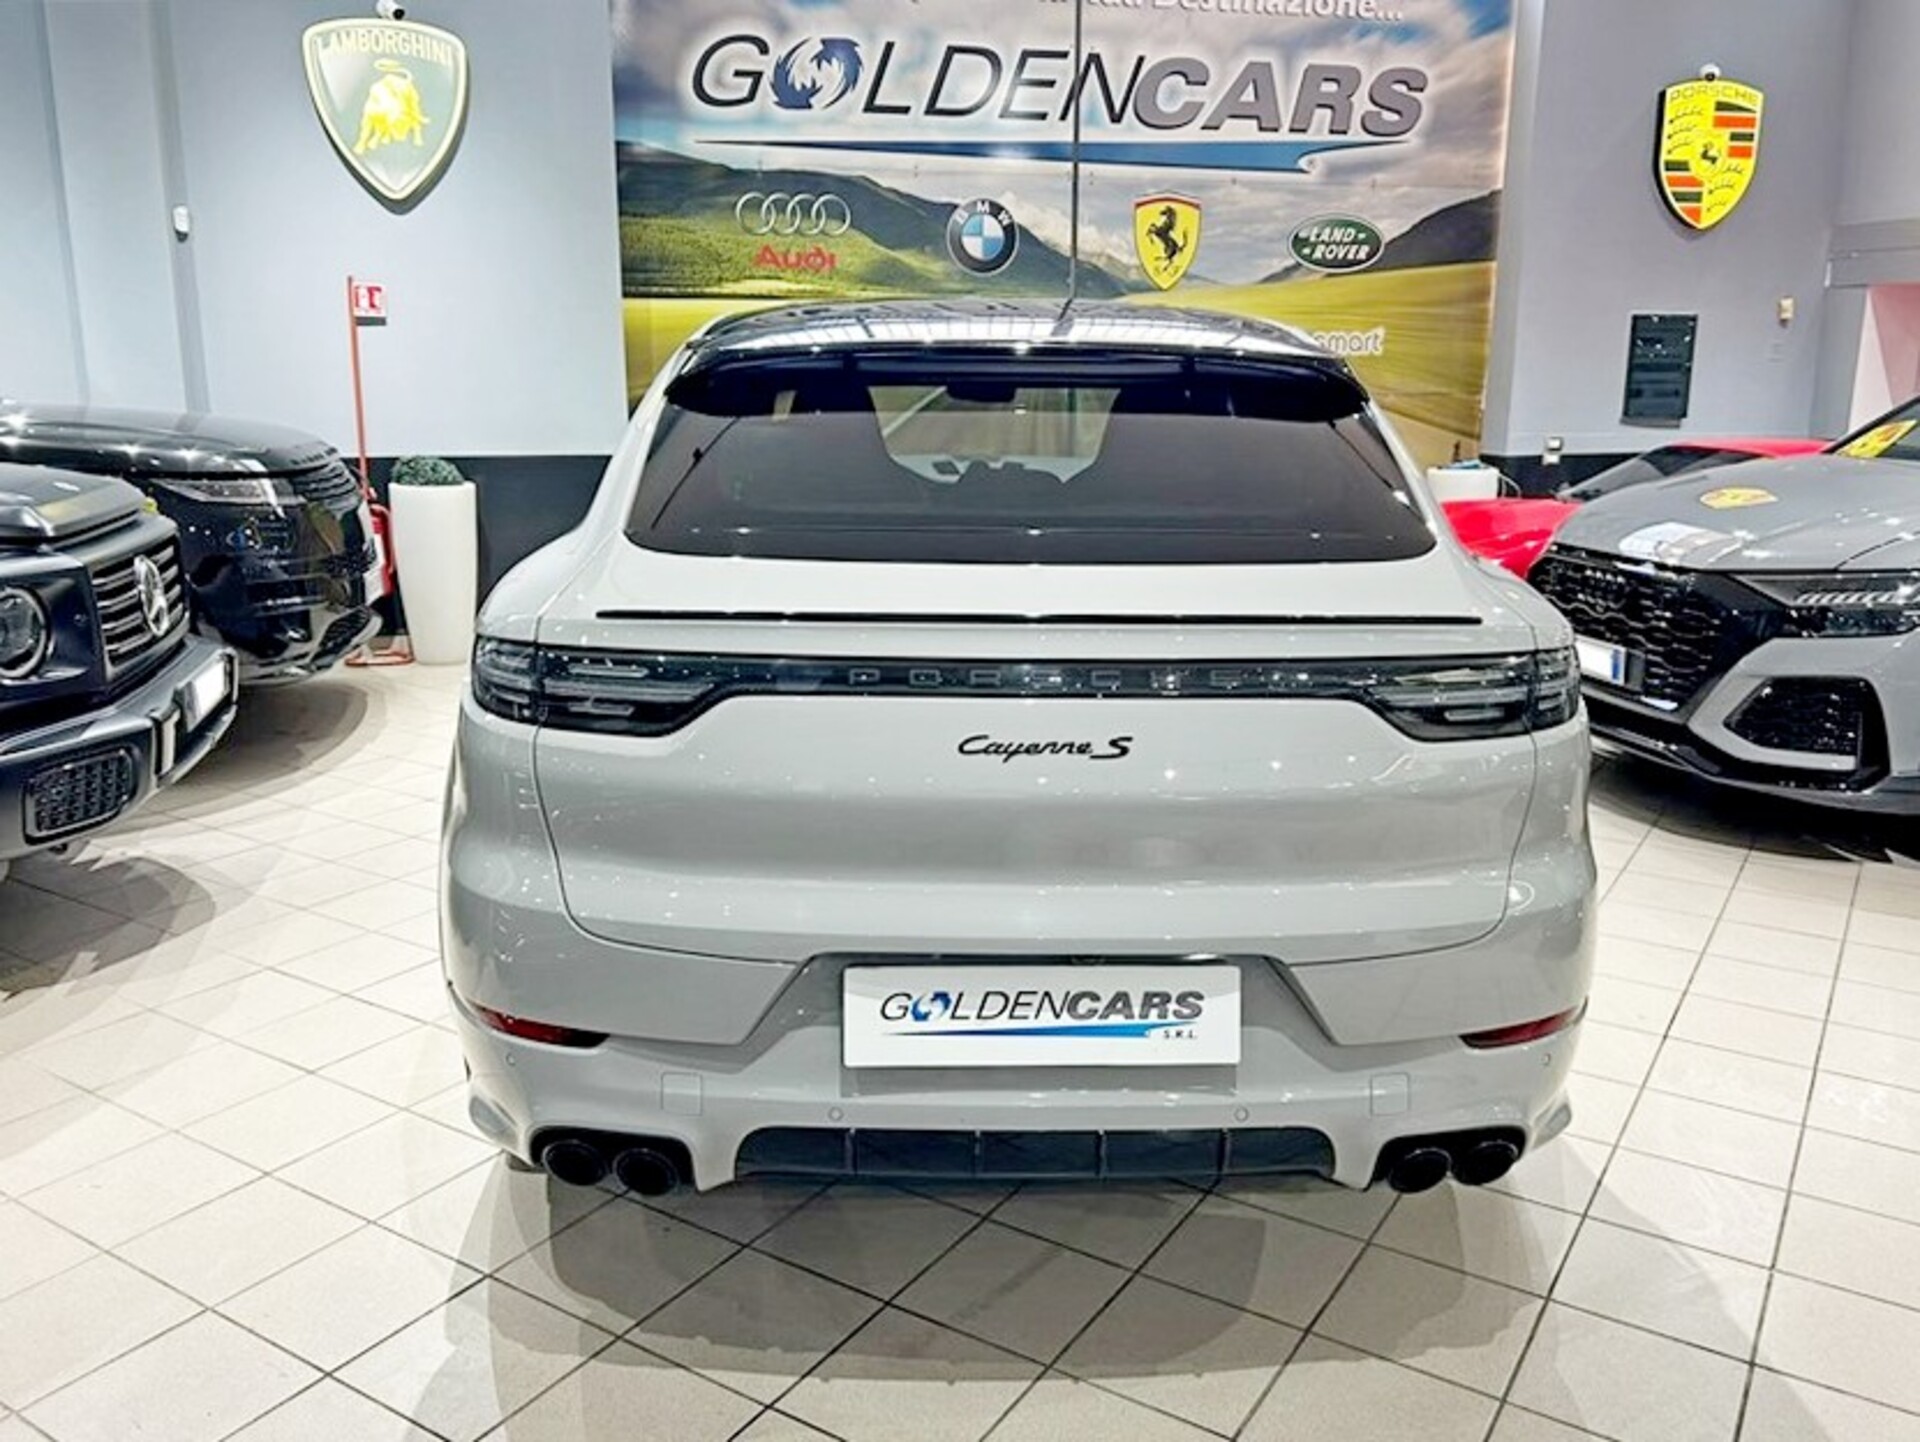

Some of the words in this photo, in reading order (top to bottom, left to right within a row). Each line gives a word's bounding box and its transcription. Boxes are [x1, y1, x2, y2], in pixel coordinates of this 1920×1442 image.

[1152, 0, 1404, 20] snazione...
[316, 28, 454, 67] LAMBORGHINI
[692, 34, 1429, 137] GOLDENCARS
[1669, 84, 1760, 106] PORSCHE
[953, 200, 1013, 227] BMW
[1309, 226, 1356, 242] LAND
[753, 244, 838, 272] Audi
[1312, 244, 1370, 260] ROVER
[1314, 327, 1384, 355] smart
[849, 668, 1243, 687] PORSCHE
[957, 735, 1092, 763] Cayenne
[1089, 737, 1134, 760] S
[879, 990, 1205, 1022] GOLDENCARS
